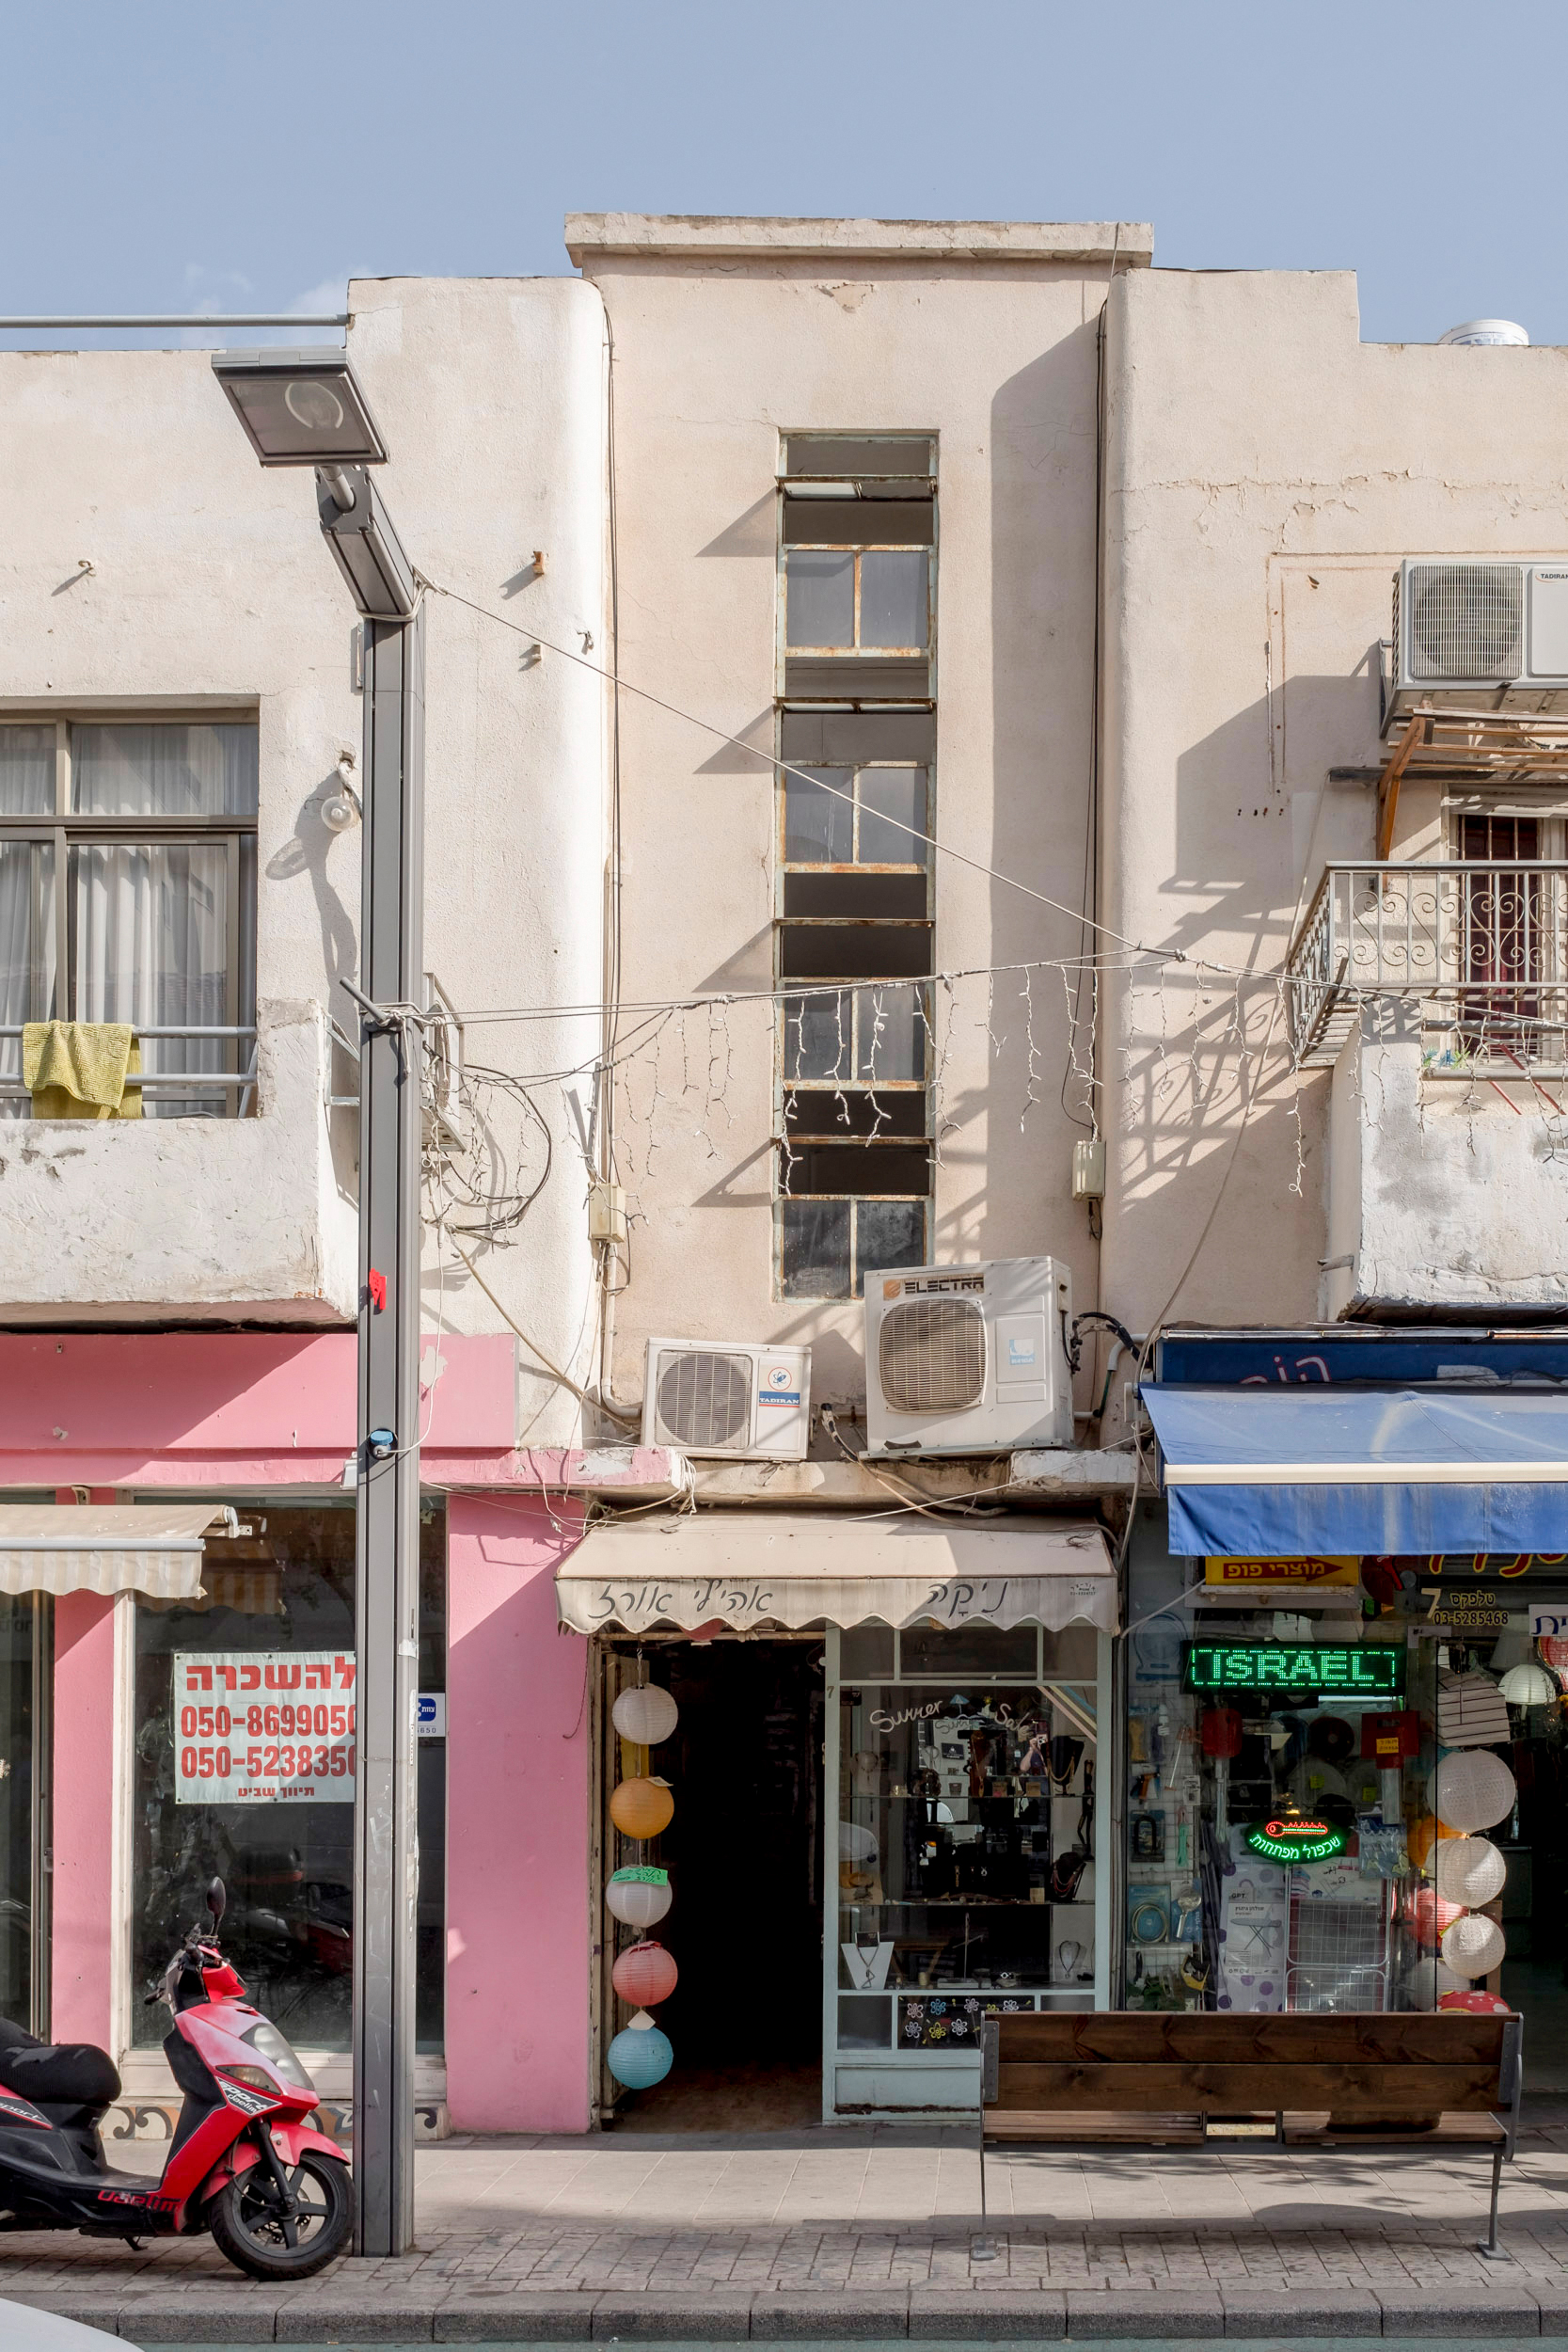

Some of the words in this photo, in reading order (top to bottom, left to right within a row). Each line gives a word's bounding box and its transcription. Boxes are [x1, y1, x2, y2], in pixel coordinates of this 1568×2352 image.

[905, 1277, 984, 1294] ELECTRA
[1270, 1563, 1324, 1576] מוצרי
[1420, 1587, 1442, 1618] 7
[1449, 1589, 1496, 1609] טלפקס
[1433, 1611, 1509, 1626] 03-5285468
[186, 1656, 356, 1691] להשכרה
[1212, 1654, 1374, 1680] ISRAEL
[827, 1685, 835, 1699] 7
[238, 1787, 276, 1797] שביט
[279, 1787, 314, 1798] תיווך
[1249, 1834, 1300, 1859] מפתחות
[1302, 1836, 1340, 1859] שכפול
[219, 2080, 268, 2110] sport
[227, 2093, 258, 2113] daelim
